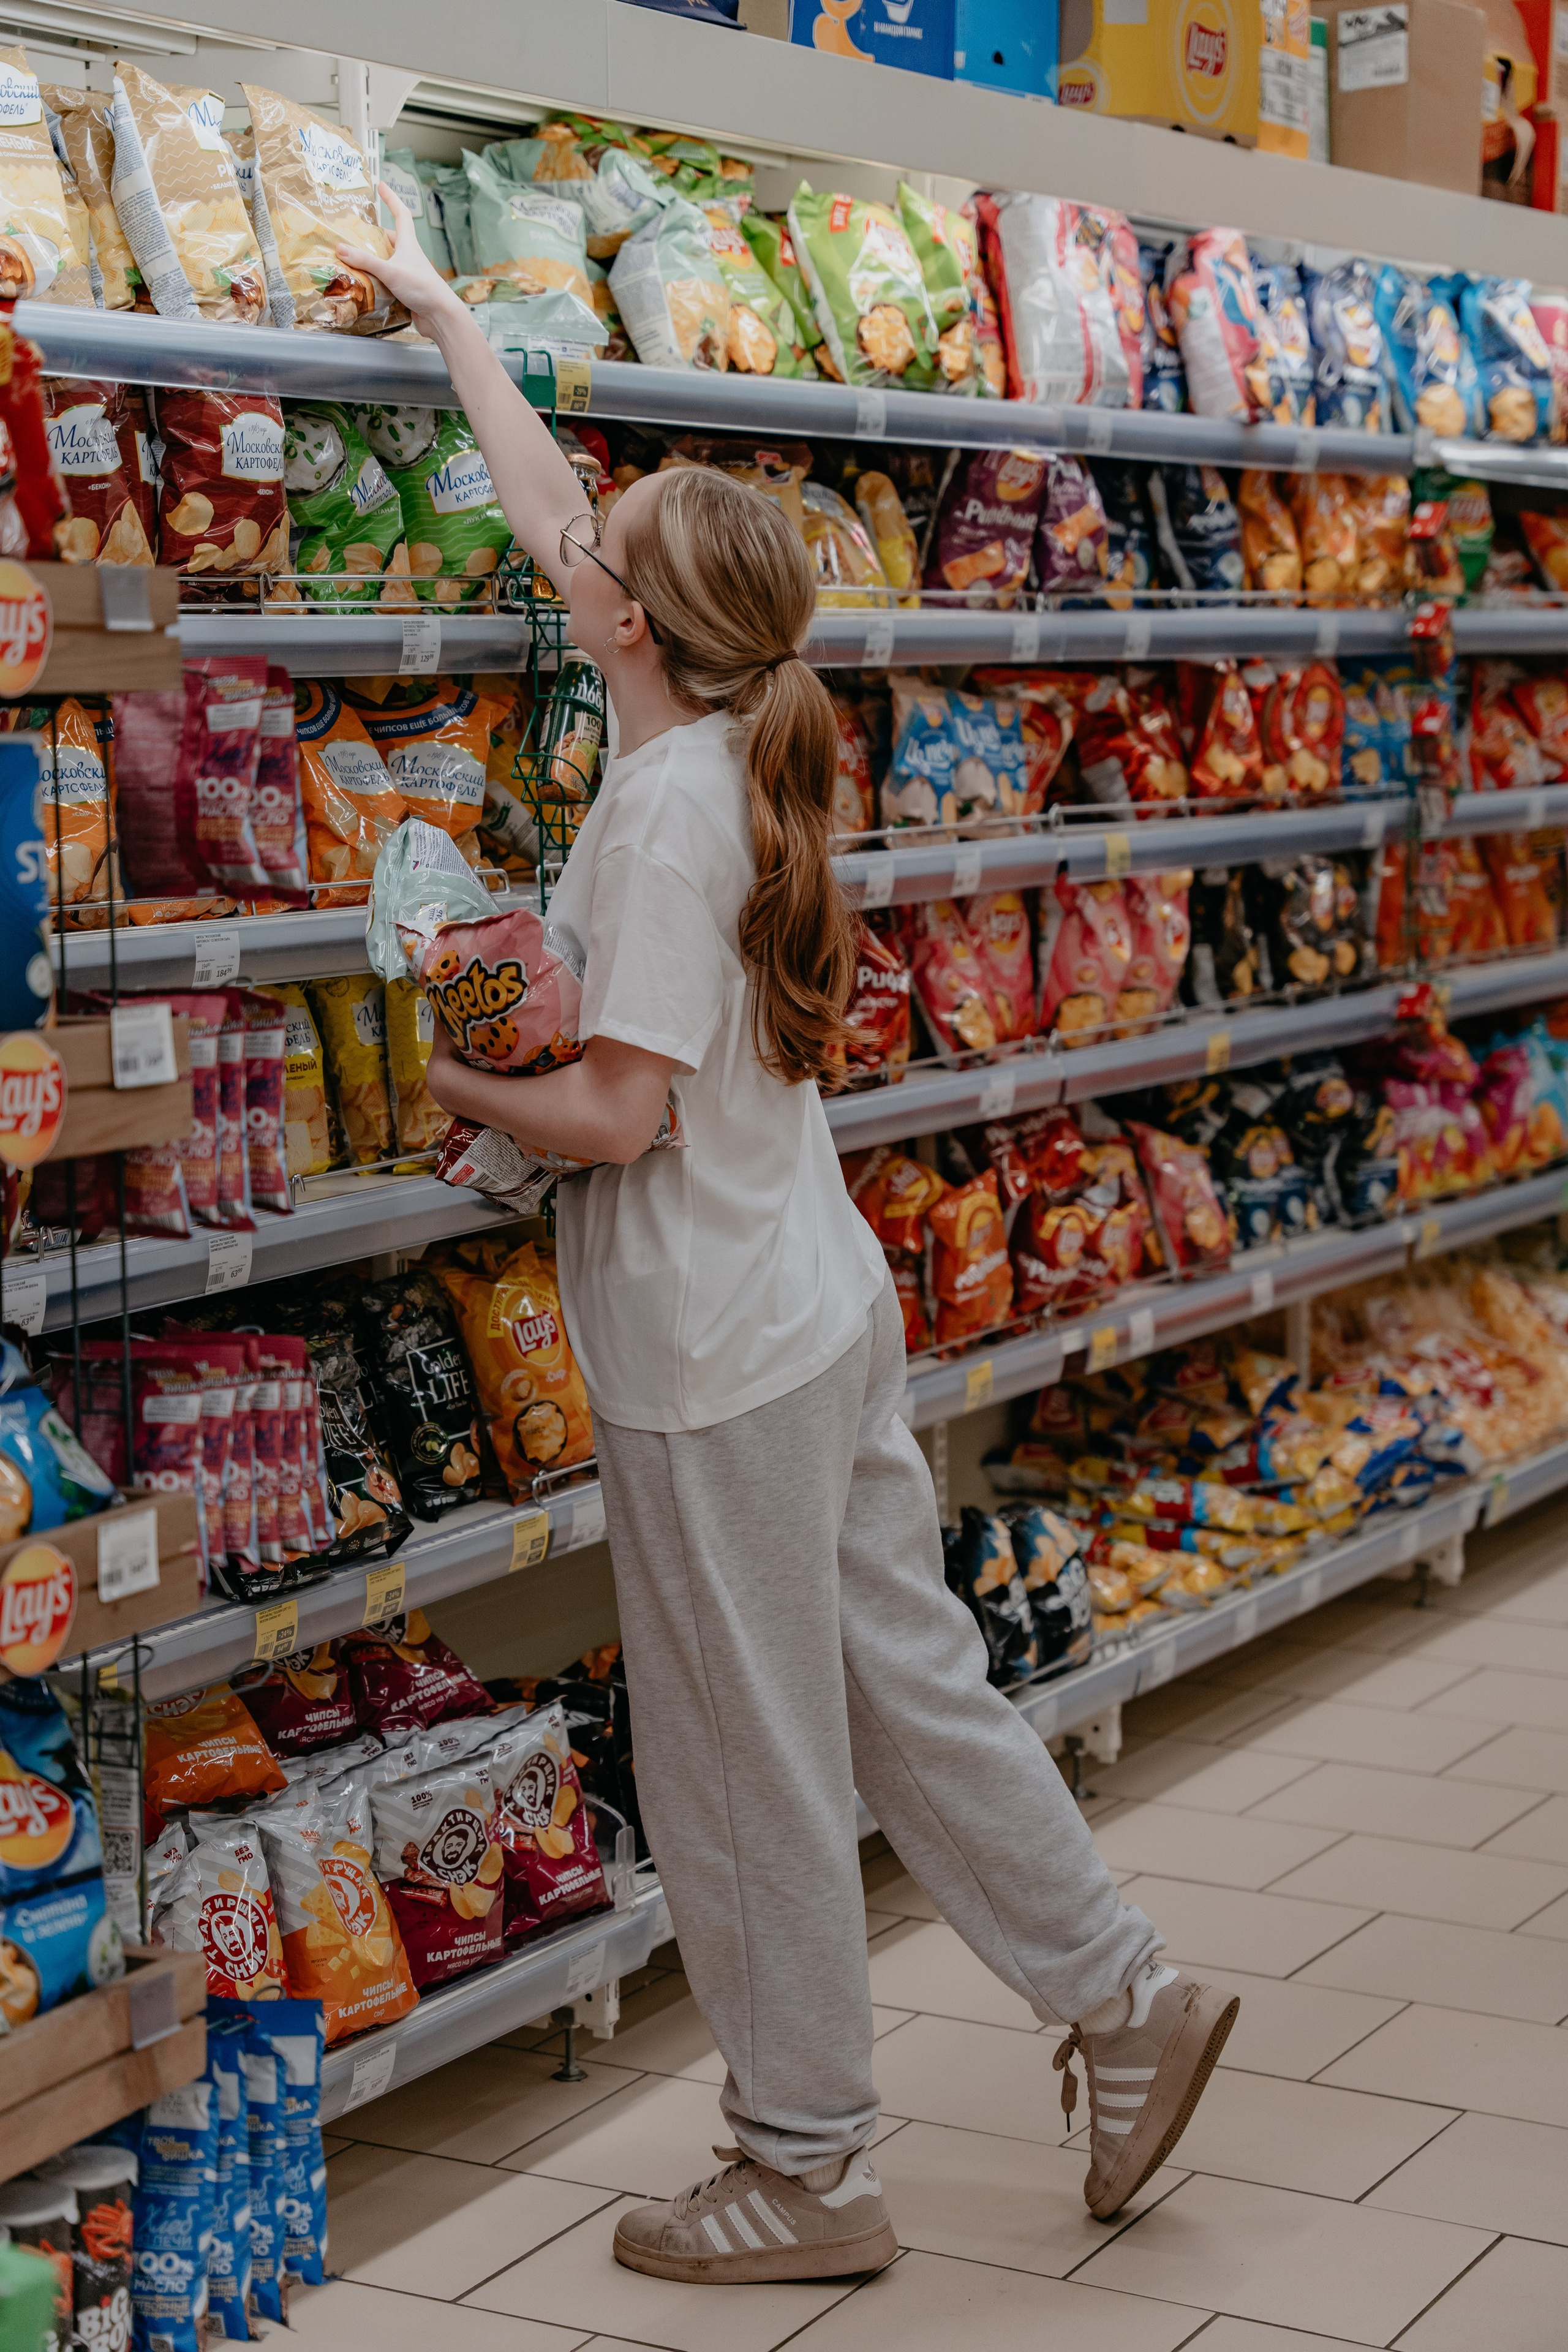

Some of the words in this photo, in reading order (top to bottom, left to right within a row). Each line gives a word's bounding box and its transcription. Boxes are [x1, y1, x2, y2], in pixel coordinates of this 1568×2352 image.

[0, 77, 40, 99] овский
[0, 104, 24, 115] ОФЕЛЬ
[47, 424, 116, 450] Московский
[227, 431, 282, 454] Московск
[61, 447, 118, 466] КАРТОФЕЛЬ
[88, 482, 111, 491] «БЕКОН»
[350, 469, 391, 508] Москов
[425, 463, 491, 497] Московс
[366, 484, 396, 510] КАРТОФЕЛ
[455, 483, 494, 503] КАРТОФЕ
[0, 593, 44, 667] y's
[374, 719, 408, 734] ЧИПСОВ
[409, 718, 428, 730] ЕЩЕ
[428, 706, 459, 724] БОЛЬШЕ
[40, 761, 106, 782] осковски
[325, 755, 386, 775] Московски
[391, 754, 484, 787] Московский
[42, 782, 106, 797] КАРТОФЕЛЬ
[339, 774, 391, 786] КАРТОФЕЛЬ
[399, 777, 478, 797] КАРТОФЕЛЬ
[284, 1058, 317, 1074] ЛЕНЫЙ
[0, 1061, 59, 1137] ay's
[231, 1267, 243, 1278] 6399
[21, 1316, 35, 1327] 6399
[514, 1313, 556, 1354] Lay's
[428, 1370, 470, 1404] LIFE
[318, 1400, 340, 1419] olden
[1, 1569, 71, 1646] Lay's
[279, 1629, 292, 1638] -24%
[305, 1708, 340, 1723] ЧИПСЫ
[197, 1736, 238, 1748] ЧИПСЫ
[176, 1744, 263, 1763] КАРТОФЕЛЬНЫЕ
[410, 1790, 432, 1804] 100%
[0, 1778, 59, 1838] ay's
[522, 1803, 552, 1827] СНЭК
[423, 1811, 484, 1865] ТРАКТИРЩИК
[163, 1847, 179, 1859] БЕЗ
[234, 1845, 250, 1857] БЕЗ
[238, 1852, 254, 1864] ГМО
[437, 1859, 477, 1884] СНЭК
[556, 1865, 584, 1883] ЧИПСЫ
[538, 1867, 603, 1905] КАРТОФЕЛЬНЫЕ
[427, 1936, 502, 1962] КАРТОФЕЛЬНЫЕ
[454, 1931, 486, 1947] ЧИПСЫ
[225, 1945, 266, 1979] СНЭК
[363, 1978, 394, 1997] ЧИПСЫ
[338, 1981, 408, 2019] КАРТОФЕЛЬНЫЕ
[374, 2008, 385, 2019] сыр
[772, 2199, 796, 2225] CAMPUS
[134, 2278, 187, 2294] МАСЛО
[77, 2286, 129, 2339] BIG
